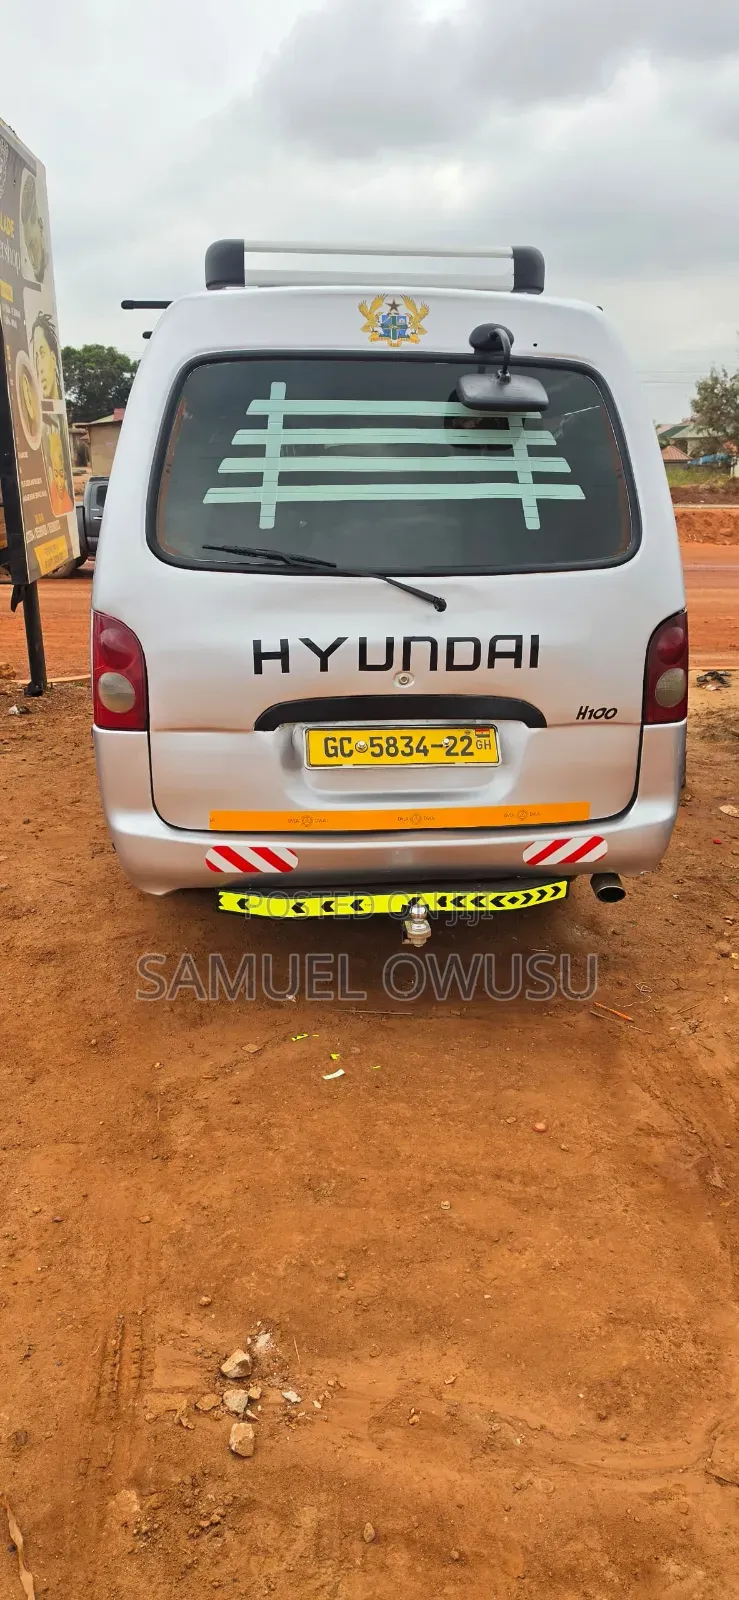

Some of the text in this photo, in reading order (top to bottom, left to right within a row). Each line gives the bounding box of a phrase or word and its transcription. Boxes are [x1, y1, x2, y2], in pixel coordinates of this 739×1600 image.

[252, 634, 540, 675] HYUNDAI
[576, 705, 619, 721] H100
[475, 739, 492, 751] GH
